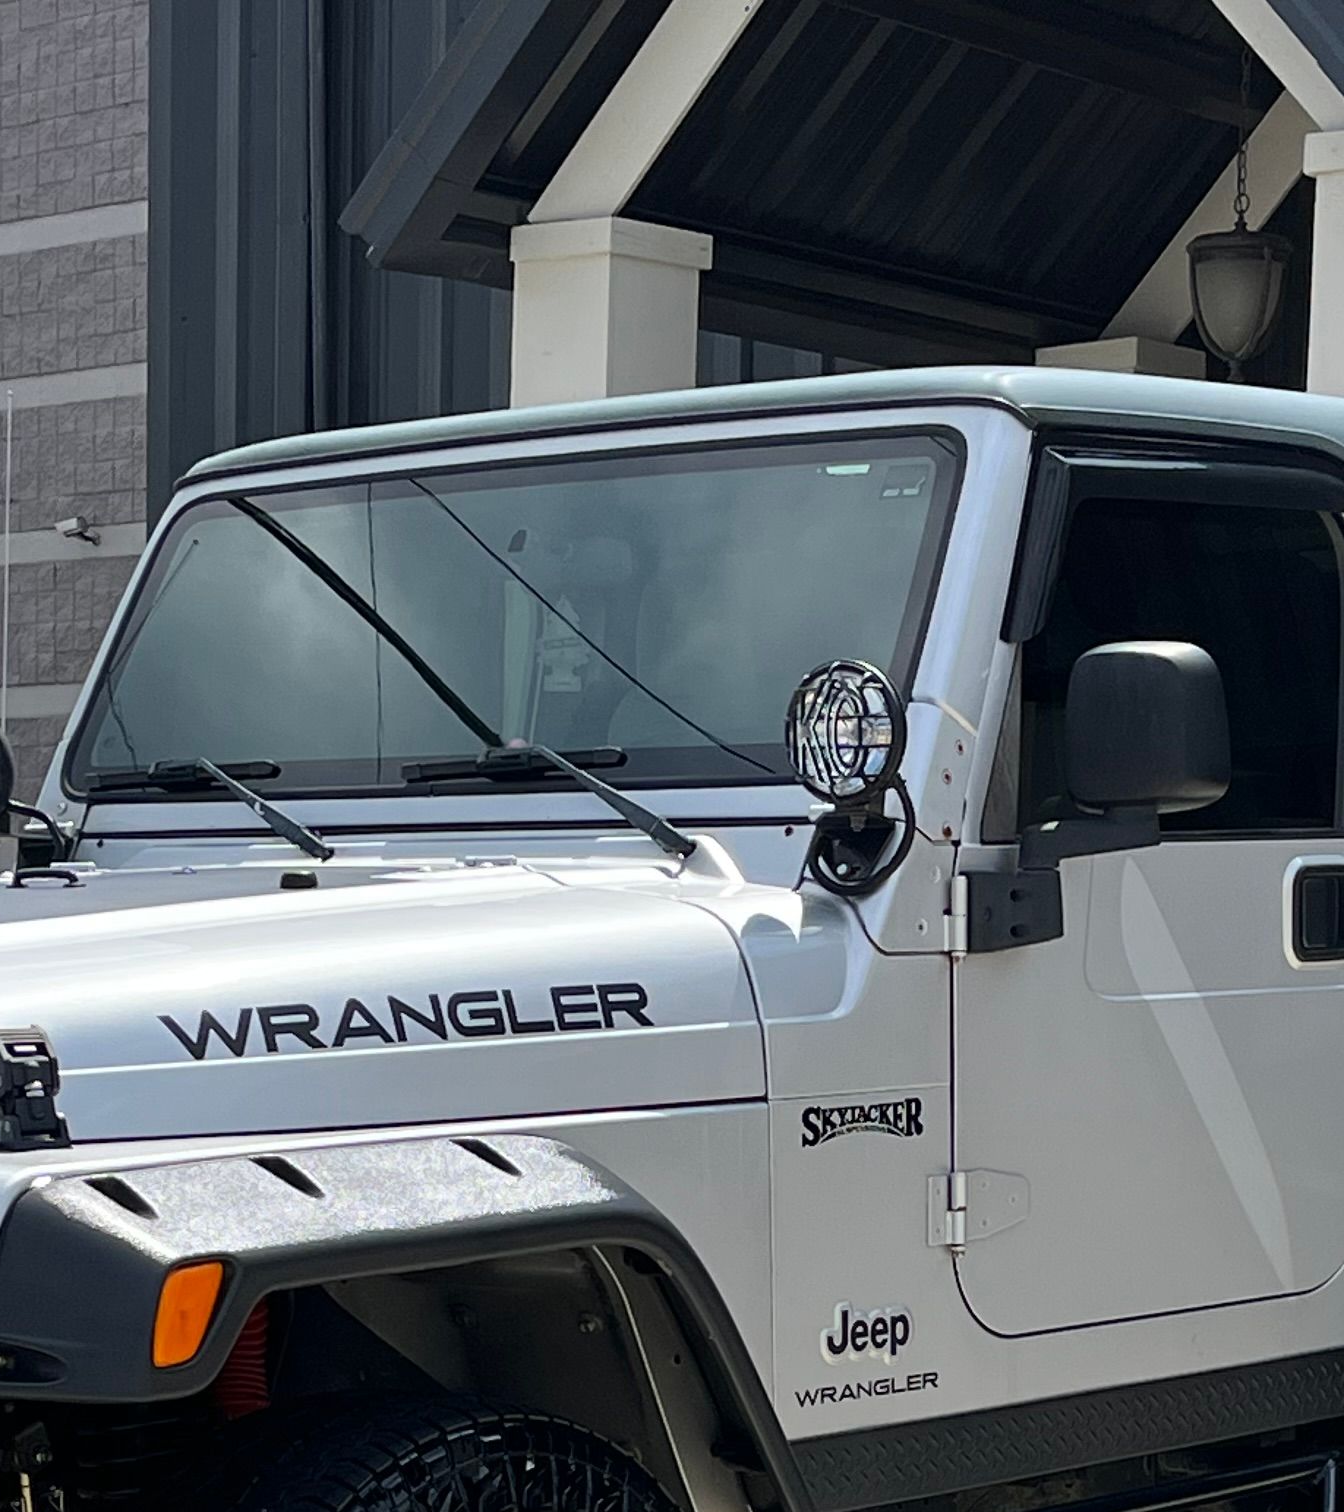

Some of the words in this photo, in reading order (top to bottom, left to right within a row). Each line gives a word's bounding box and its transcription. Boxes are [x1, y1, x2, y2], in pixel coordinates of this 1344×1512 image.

[156, 983, 655, 1060] WRANGLER
[802, 1097, 924, 1147] SKYJACKER
[827, 1309, 909, 1355] Jeep
[794, 1372, 939, 1408] WRANGLER
